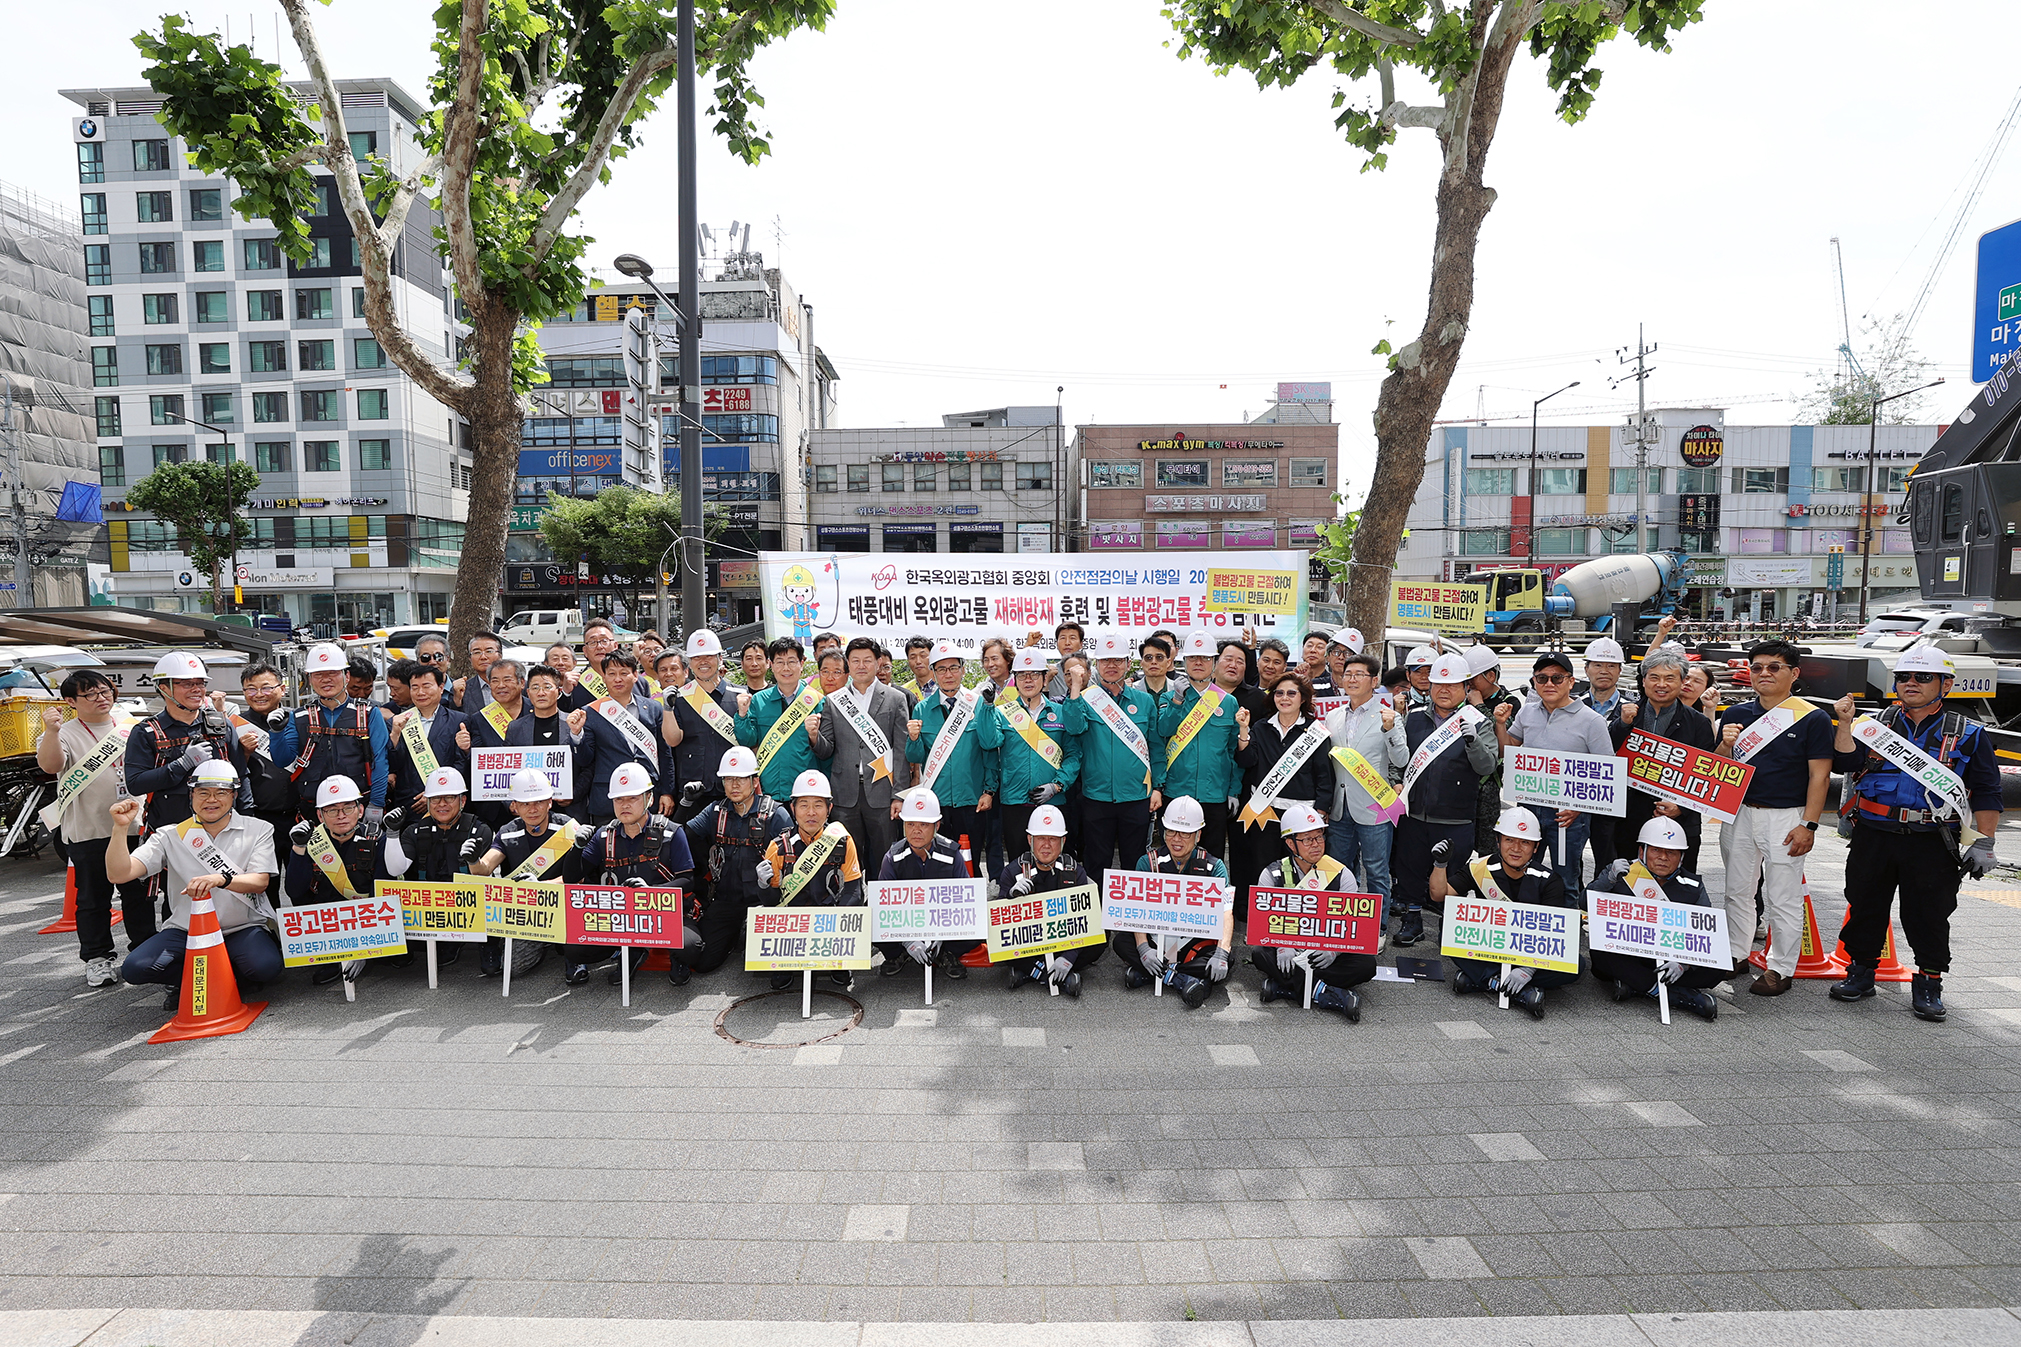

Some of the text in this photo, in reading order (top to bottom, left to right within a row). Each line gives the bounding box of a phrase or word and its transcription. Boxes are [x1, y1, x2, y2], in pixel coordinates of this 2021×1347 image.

[725, 389, 746, 400] 2249
[725, 400, 750, 410] -6188
[1141, 439, 1206, 451] K.max gym
[1684, 441, 1723, 456] 마사지
[1845, 449, 1909, 461] BALET
[548, 451, 613, 468] officenex
[1165, 464, 1201, 475] 무에타이
[857, 506, 954, 516] 위너스 댄스스포츠 2관
[1153, 496, 1261, 510] 스포츠마사지
[1807, 504, 1889, 517] 100세 건강
[1102, 535, 1138, 545] 맛사지
[905, 569, 1008, 586] 한국옥외광고협회
[1011, 569, 1051, 586] 중앙회
[1141, 569, 1180, 586] 시행일
[1213, 573, 1292, 590] 불법광고물 근절하여
[1212, 589, 1246, 604] 명품도시
[1398, 587, 1479, 605] 불법광고물 근절하여
[848, 595, 1192, 627] 태풍대비 옥외광고물 재해방재 훈련 및 불법광고물
[1397, 603, 1431, 619] 명품도시
[1954, 678, 1991, 692] -3440
[838, 694, 860, 718] 광고물
[776, 707, 803, 736] 광고물
[947, 709, 966, 736] 간판은
[1102, 703, 1139, 744] 불법광고물
[406, 725, 427, 755] 광고물
[82, 741, 119, 773] 광고물
[477, 751, 565, 770] 불법광고물 정비 하여
[1261, 734, 1318, 799] 광고물 안전지킴이
[1514, 753, 1615, 781] 최고기술 자랑말고
[1625, 732, 1746, 788] 광고물은 도시의
[1883, 741, 1929, 773] 광고물
[1514, 773, 1615, 803] 안전시공 자랑하자
[1630, 756, 1709, 799] 얼굴입니다
[1524, 795, 1557, 804] 한국옥외광고협회
[434, 889, 477, 908] 근절하여
[484, 884, 559, 908] 광고물 근절하여
[570, 889, 676, 912] 광고물은 도시의
[879, 885, 975, 906] 최고기술 자랑말고
[1108, 874, 1222, 908] 광고법규 준수
[990, 891, 1091, 926] 불법광고물 정비 하여
[1107, 905, 1218, 927] 우리 모두가 지켜야할 약속입니다
[1255, 892, 1376, 918] 광고물은 도시의
[1596, 898, 1717, 933] 불법광고물 정비 하여
[283, 904, 396, 938] 광고법규준수
[583, 913, 653, 934] 얼굴입니다
[753, 913, 863, 934] 불법광고물 정비 하여
[878, 907, 977, 929] 안전시공 자랑하자
[1268, 915, 1347, 939] 얼굴입니다
[1456, 903, 1566, 934] 최고기술 자랑말고
[587, 935, 619, 943] 한국옥외광고협회
[1000, 915, 1088, 948] 도시미관 조성하자
[1270, 938, 1306, 947] 한국옥외광고협회
[1454, 925, 1566, 958] 안전시공 자랑하자
[1605, 921, 1712, 954] 도시미관 조성하자
[287, 932, 399, 955] 우리 모두가 지켜야할 약속입니다
[760, 937, 856, 957] 도시미관 조성하자
[1616, 945, 1655, 956] 한국옥외광고협회
[193, 957, 207, 1014] 동대문구지부
